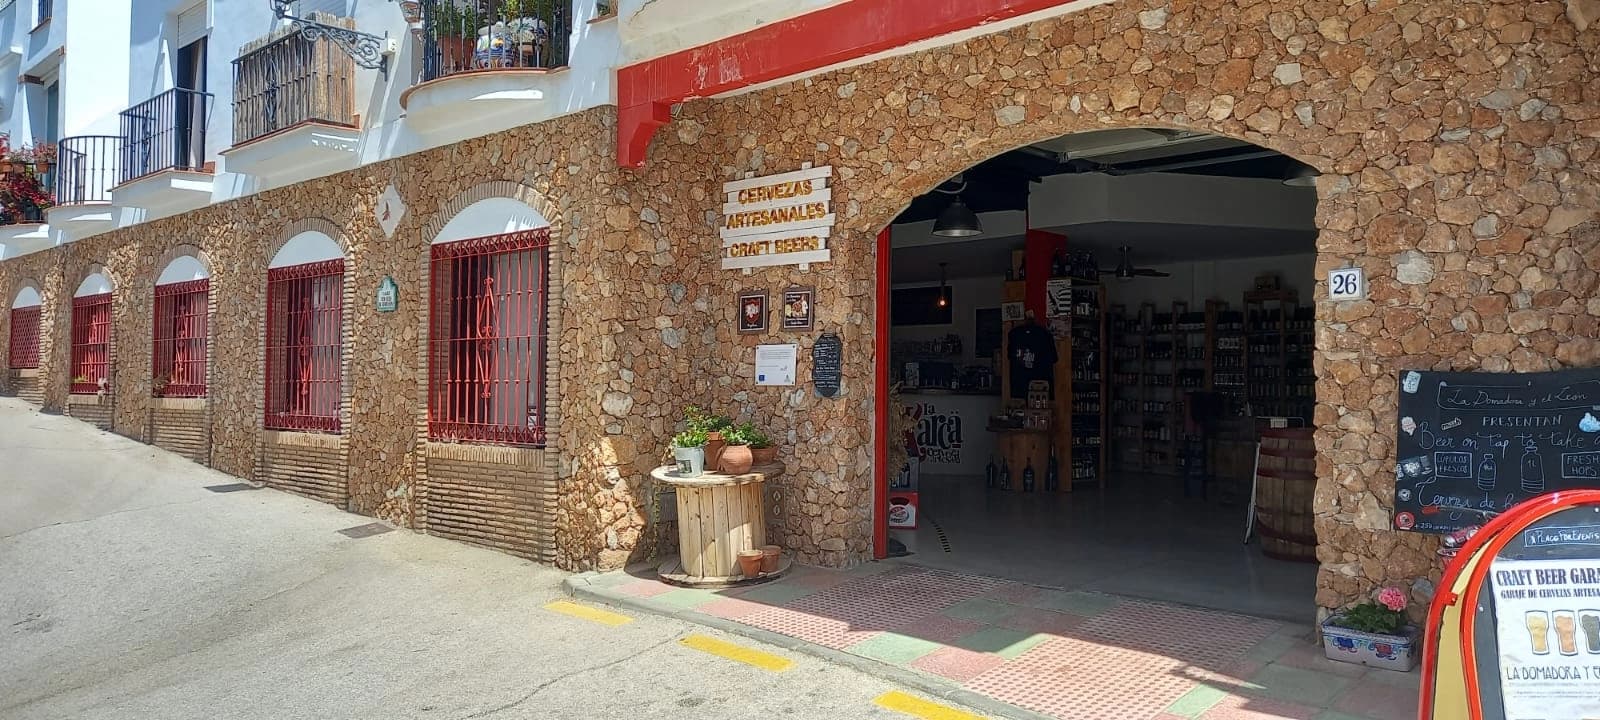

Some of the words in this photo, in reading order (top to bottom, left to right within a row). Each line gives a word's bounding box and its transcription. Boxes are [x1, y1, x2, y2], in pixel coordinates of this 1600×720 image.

[737, 180, 813, 205] CERVEZAS
[726, 202, 826, 230] ARTESANALES
[730, 240, 770, 257] CRAFT
[774, 235, 819, 255] BEERS
[1332, 273, 1357, 295] 26
[924, 402, 935, 415] la
[1482, 414, 1562, 427] PRESENTAN
[1418, 421, 1455, 450] Beer
[1462, 437, 1479, 450] on
[1480, 433, 1509, 459] tap
[1567, 454, 1599, 465] FRESH
[1571, 466, 1597, 477] HOPS
[1480, 491, 1496, 509] de
[1496, 569, 1532, 586] CRAFT
[1535, 568, 1567, 585] BEER
[1501, 589, 1526, 600] GARAJE
[1528, 588, 1538, 599] DE
[1539, 588, 1571, 598] CERVEZAS
[1506, 665, 1520, 680] LA
[1522, 664, 1581, 680] DOMADORA
[1583, 665, 1590, 680] Y
